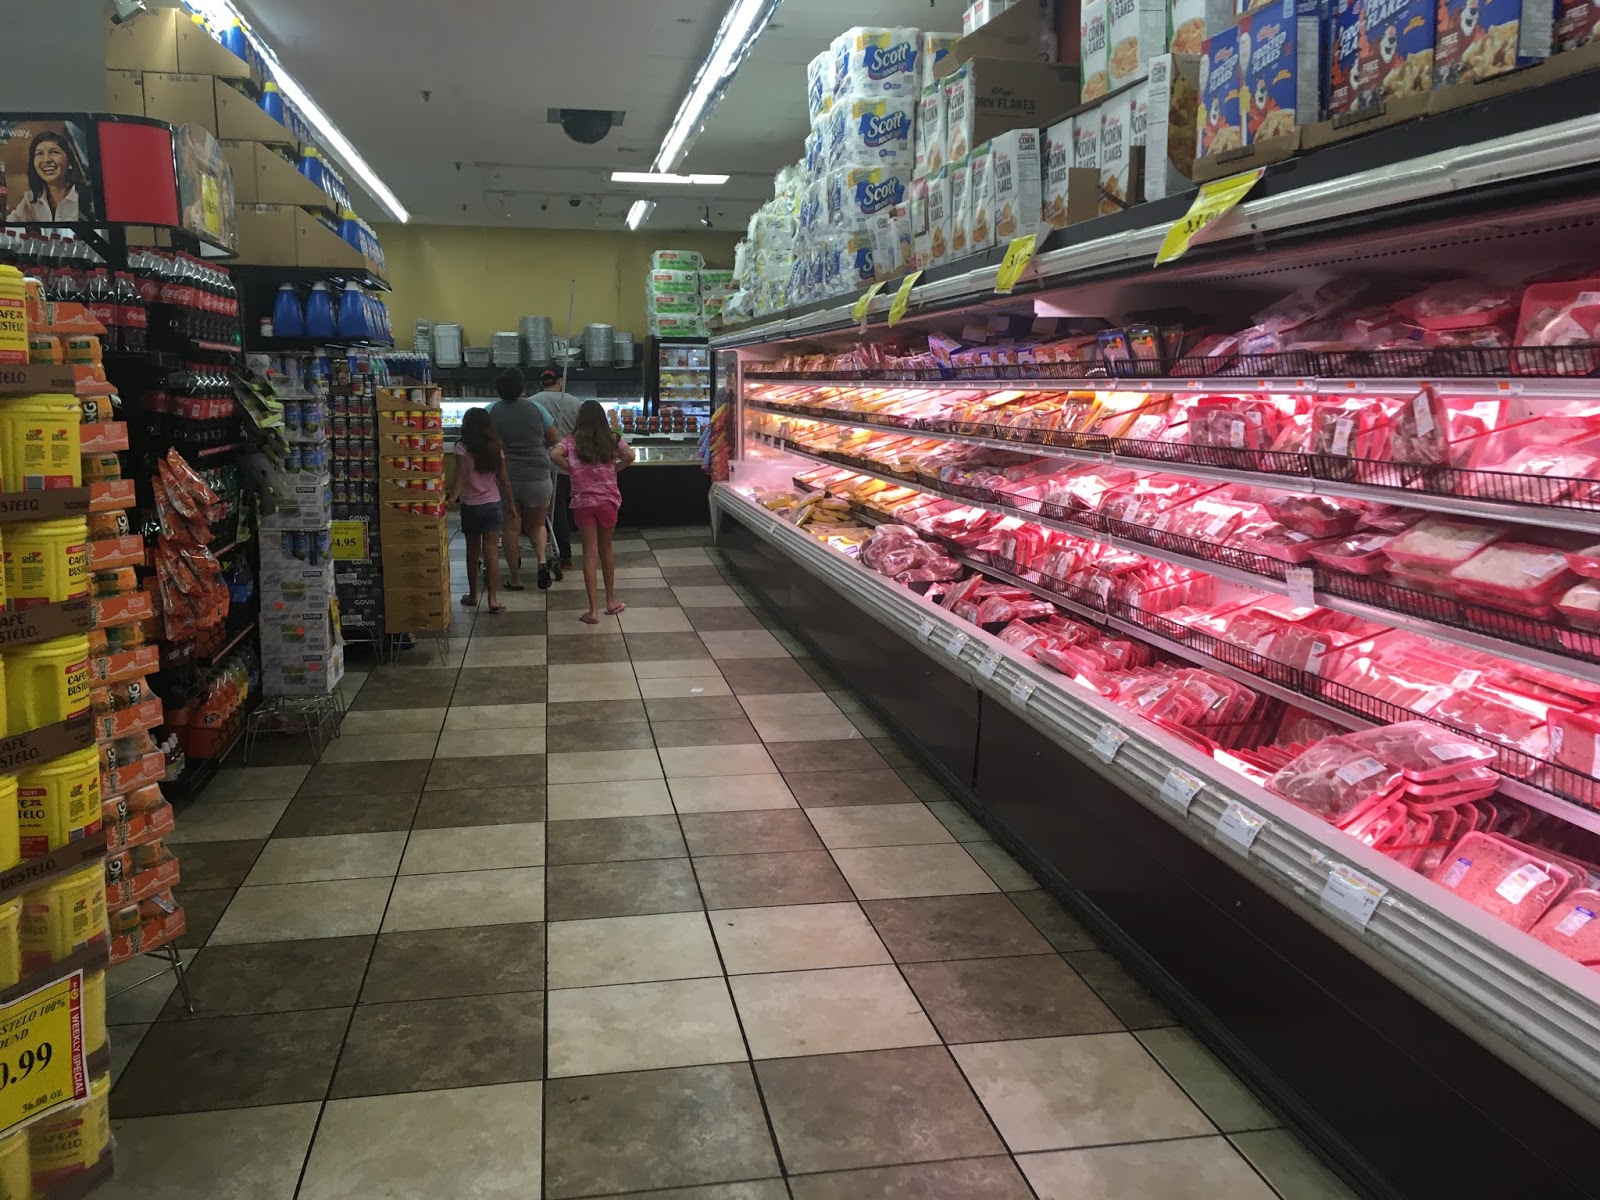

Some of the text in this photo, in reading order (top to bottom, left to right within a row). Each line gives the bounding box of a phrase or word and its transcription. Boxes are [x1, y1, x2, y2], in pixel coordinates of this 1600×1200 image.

[1088, 20, 1105, 42] CORN
[1088, 37, 1105, 55] FLAKES
[871, 42, 909, 71] Scott
[974, 97, 1036, 111] ORN FLAKES
[867, 111, 903, 138] Scott
[1135, 113, 1147, 134] COR
[8, 130, 32, 139] way.
[878, 132, 893, 144] 1000
[1019, 143, 1035, 151] FLAKES
[863, 177, 897, 205] Scott
[874, 200, 889, 212] 1000
[0, 310, 16, 319] AFE
[0, 321, 24, 332] STELO
[0, 499, 39, 513] STELO
[0, 613, 25, 626] AFE
[0, 625, 37, 643] STELO
[68, 683, 88, 696] BUSTE
[0, 737, 28, 752] AFE
[0, 747, 38, 768] STELO
[18, 809, 45, 819] TELO
[0, 999, 66, 1035] STELO 100%
[0, 1029, 29, 1050] OUND
[72, 1013, 84, 1095] WEEKLY SPECIAL
